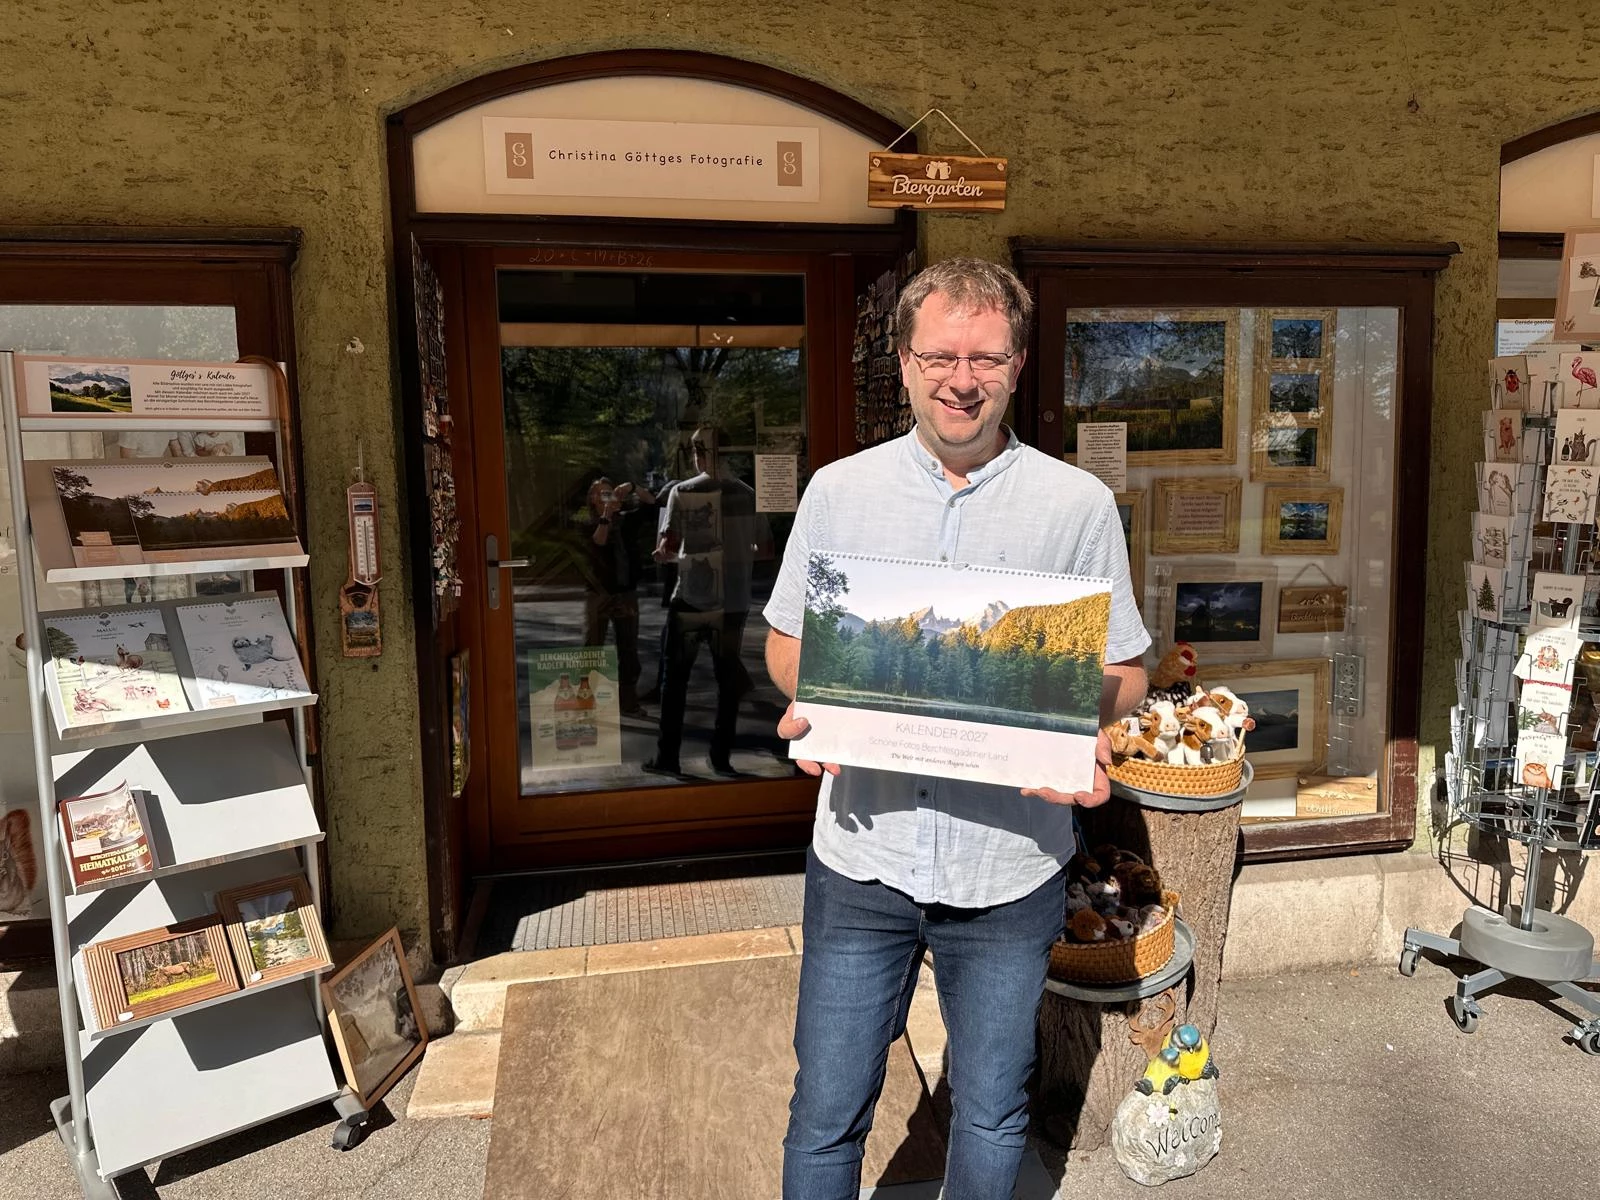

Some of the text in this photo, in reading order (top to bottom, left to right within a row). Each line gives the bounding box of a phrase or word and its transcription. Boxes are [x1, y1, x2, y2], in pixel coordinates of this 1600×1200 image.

[548, 149, 763, 168] Christina Göttges Fotografie
[892, 174, 984, 205] Biergarten
[207, 371, 236, 380] Kalender
[895, 722, 988, 742] KALENDER 2027
[899, 740, 920, 750] Fotos
[921, 743, 987, 760] Berchtesgadener
[988, 752, 1009, 761] Land
[79, 844, 148, 873] HEIMATKALENDER
